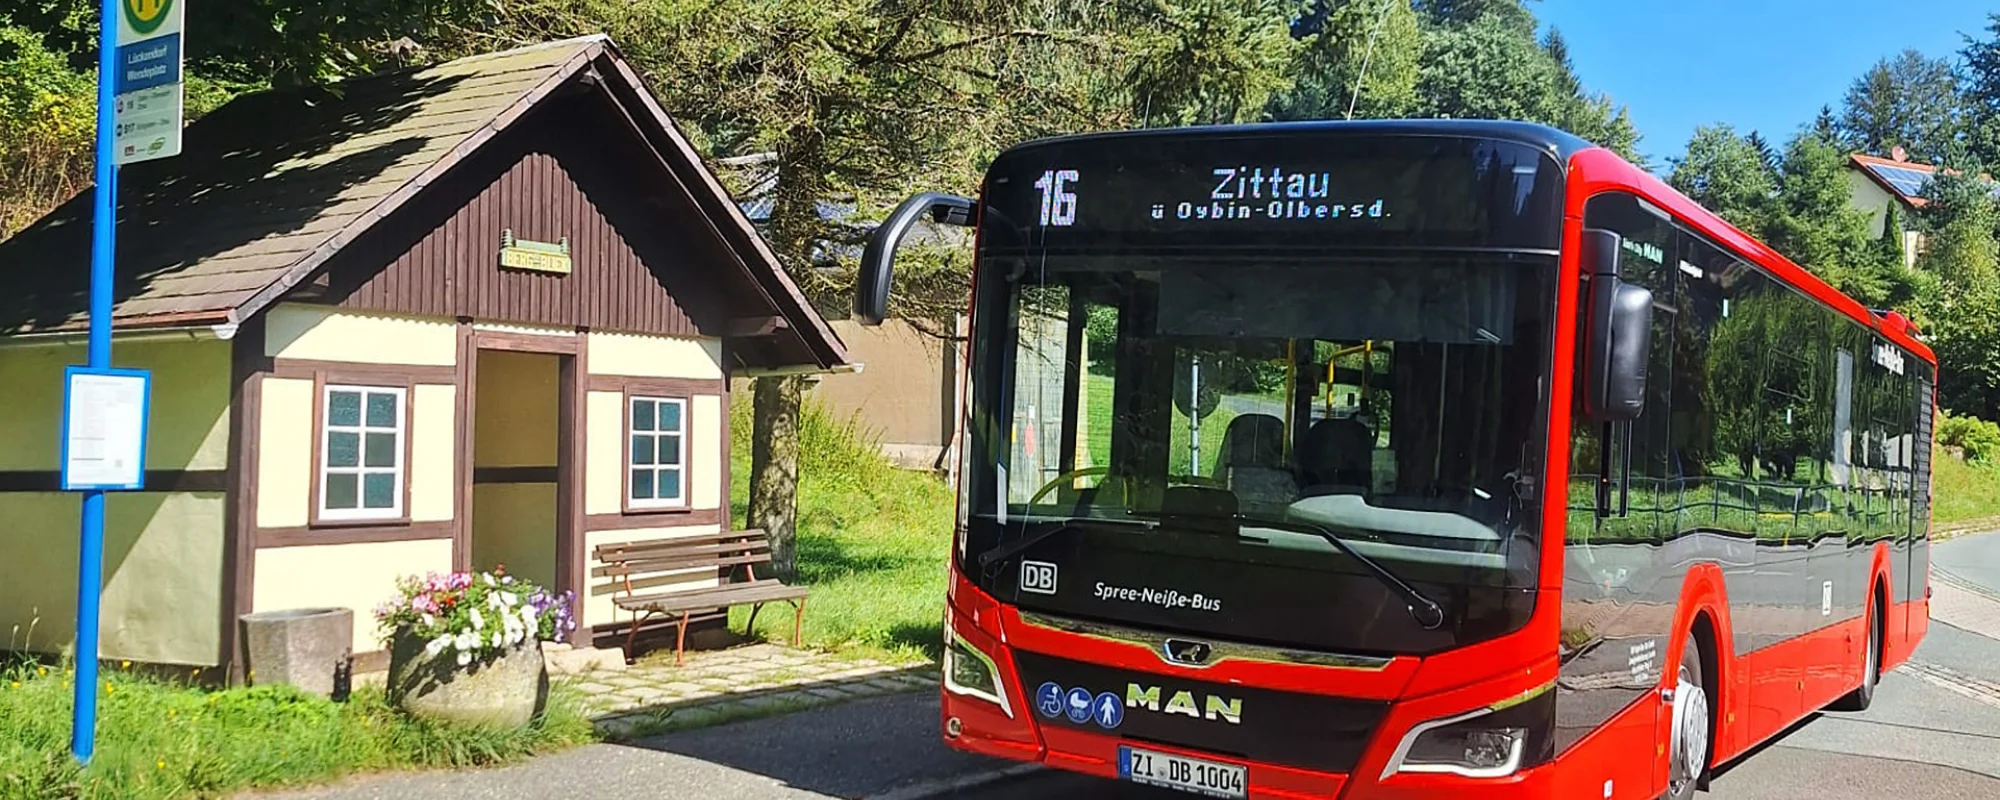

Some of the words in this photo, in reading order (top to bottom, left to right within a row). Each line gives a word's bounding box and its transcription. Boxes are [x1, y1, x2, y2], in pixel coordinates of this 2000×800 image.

[1034, 169, 1079, 226] 16
[1211, 166, 1330, 200] Zittau
[1151, 203, 1164, 219] ü
[1177, 199, 1393, 220] Oybin-Olbersd.
[1025, 565, 1053, 589] DB
[1094, 581, 1221, 612] Spree-Neiße-Bus
[1126, 682, 1243, 725] MAN
[1132, 753, 1154, 777] ZI
[1169, 759, 1191, 783] DB
[1196, 764, 1242, 792] 1004
